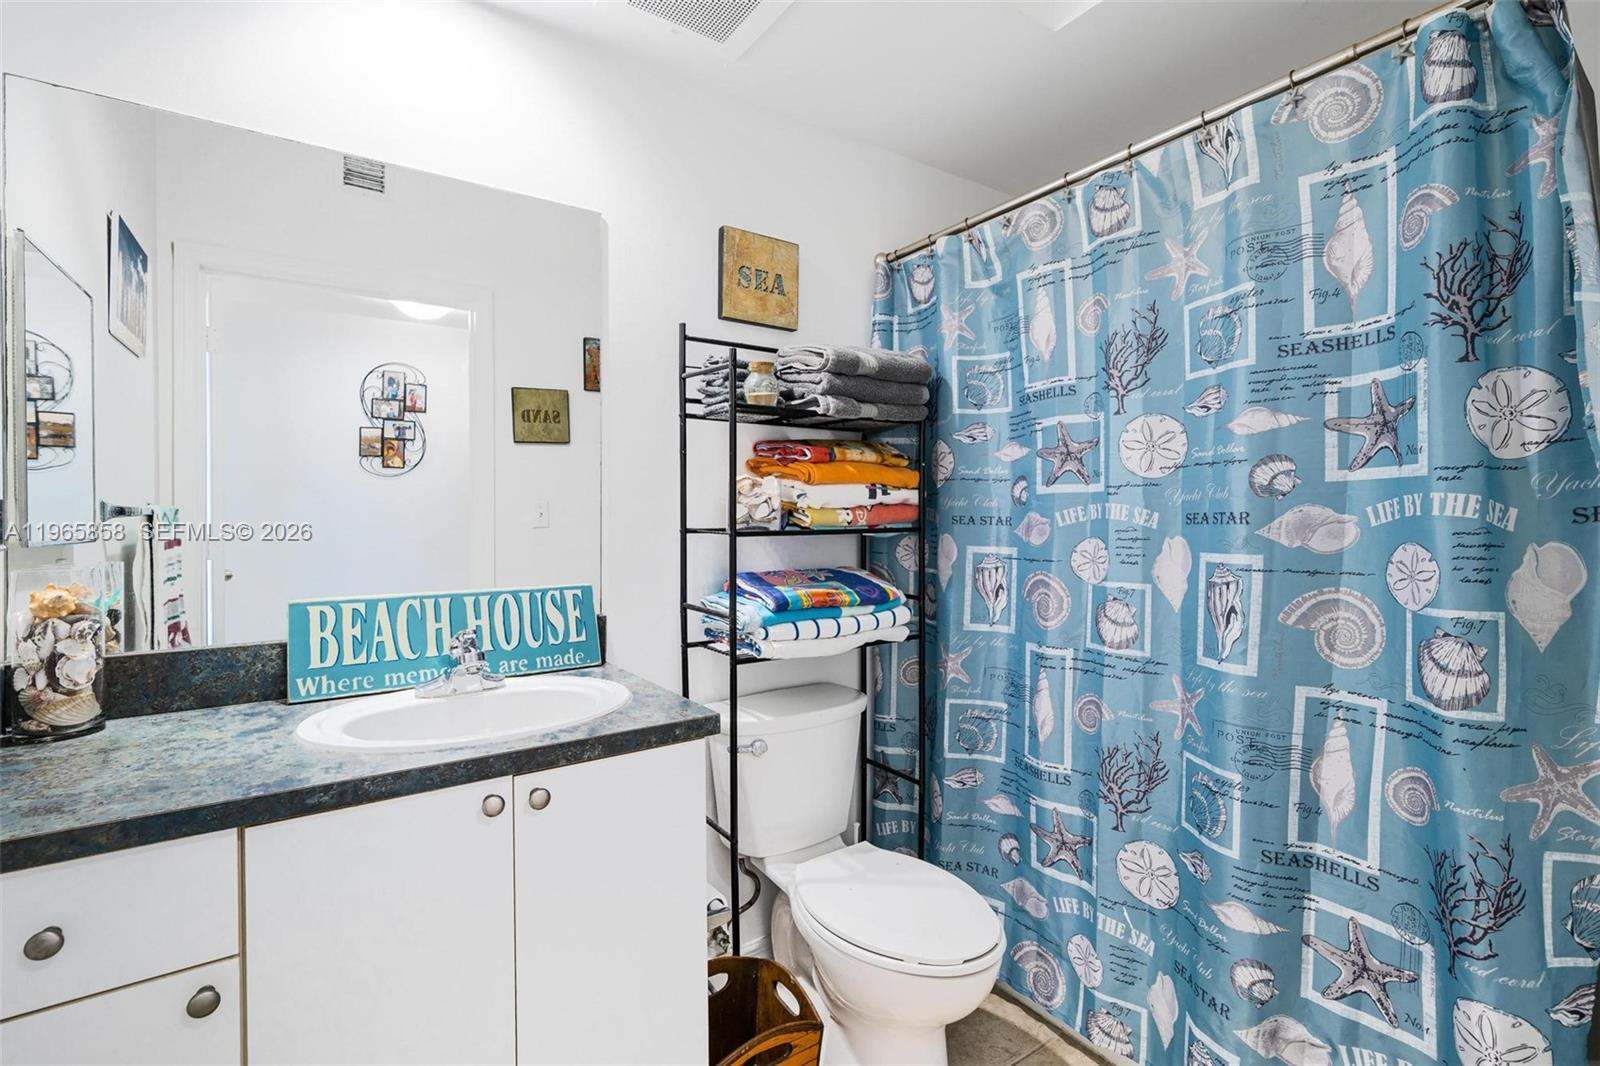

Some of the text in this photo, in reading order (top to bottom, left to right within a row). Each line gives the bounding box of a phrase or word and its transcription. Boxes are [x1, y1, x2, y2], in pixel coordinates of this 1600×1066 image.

[737, 263, 788, 297] SEA
[1308, 287, 1342, 305] Fig.4
[1277, 325, 1397, 359] SEASHELLS
[1511, 318, 1562, 344] coral
[1191, 447, 1216, 460] Sand
[951, 515, 1013, 527] SEA STAR
[1054, 506, 1087, 528] LIFE
[1104, 504, 1130, 522] THE
[1131, 505, 1160, 529] SEA
[1185, 511, 1251, 526] SEA STAR
[1365, 492, 1520, 532] LIFE BY THE SEA
[306, 588, 588, 671] BEACH HOUSE
[1450, 617, 1487, 635] Fig.7
[295, 674, 375, 697] Where
[498, 657, 530, 674] are
[535, 648, 591, 669] made.
[1217, 729, 1257, 749] POST
[1014, 755, 1072, 787] SEASHELLS
[946, 811, 969, 821] Sand
[1293, 802, 1323, 820] Fig.4
[1443, 799, 1505, 823] Nautilus
[876, 821, 917, 836] LIFE BY
[938, 860, 999, 879] SEA STAR
[1260, 849, 1381, 892] SEASHELLS
[1052, 896, 1081, 916] LIFE
[1082, 904, 1095, 922] BY
[1096, 911, 1125, 940] THE
[1128, 927, 1156, 958] SEA
[1461, 960, 1546, 989] red coral
[1174, 959, 1194, 989] SEA
[1192, 983, 1230, 1020] STAR
